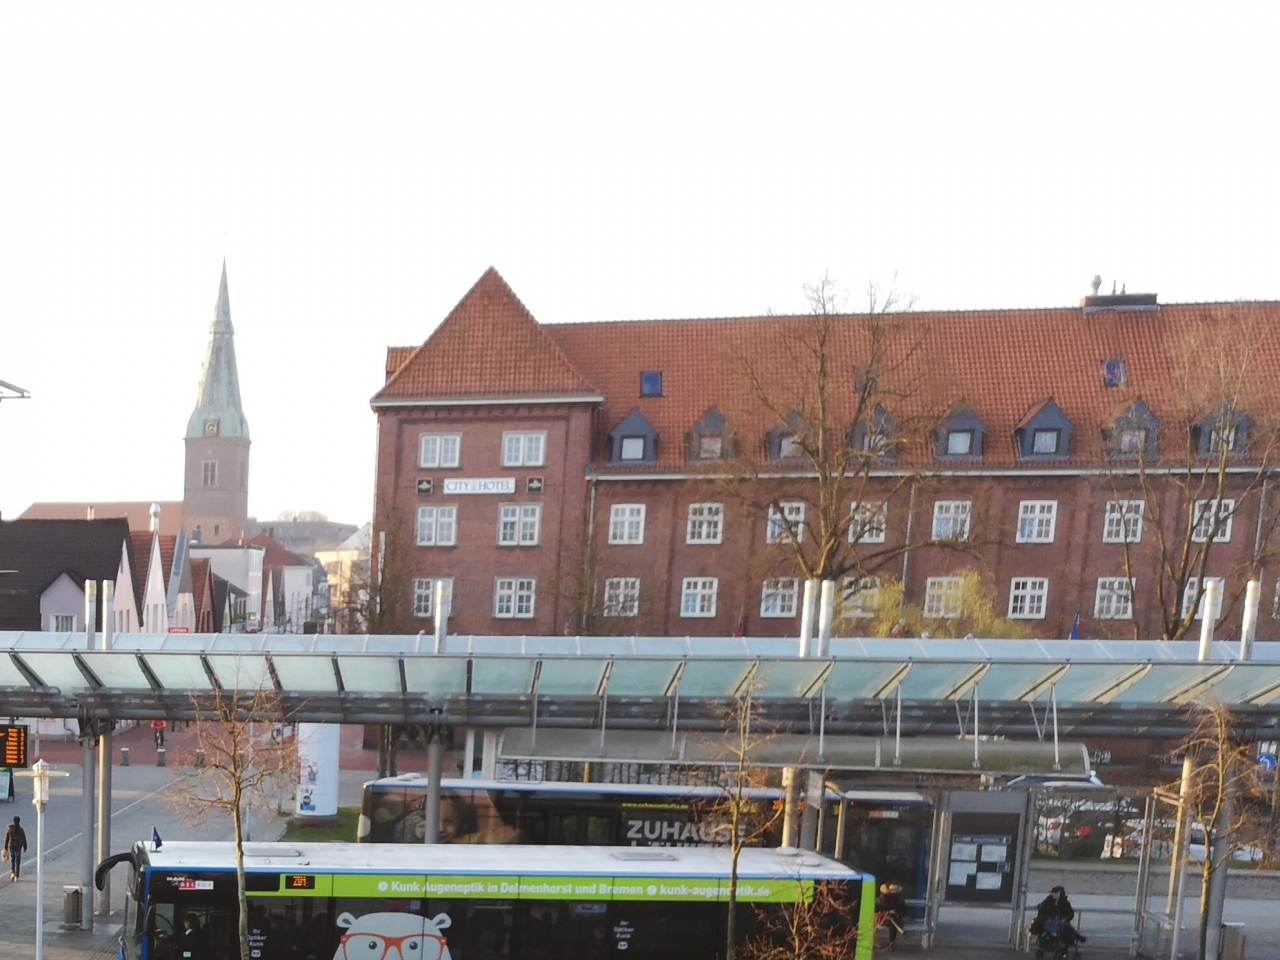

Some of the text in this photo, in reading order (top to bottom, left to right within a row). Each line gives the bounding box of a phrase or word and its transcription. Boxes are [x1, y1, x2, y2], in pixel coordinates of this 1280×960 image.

[446, 481, 510, 491] CITY HOTEL
[627, 819, 747, 841] ZUHAUSE
[391, 881, 643, 895] Kunk Augenoptik in Delmenhorst und Bremen
